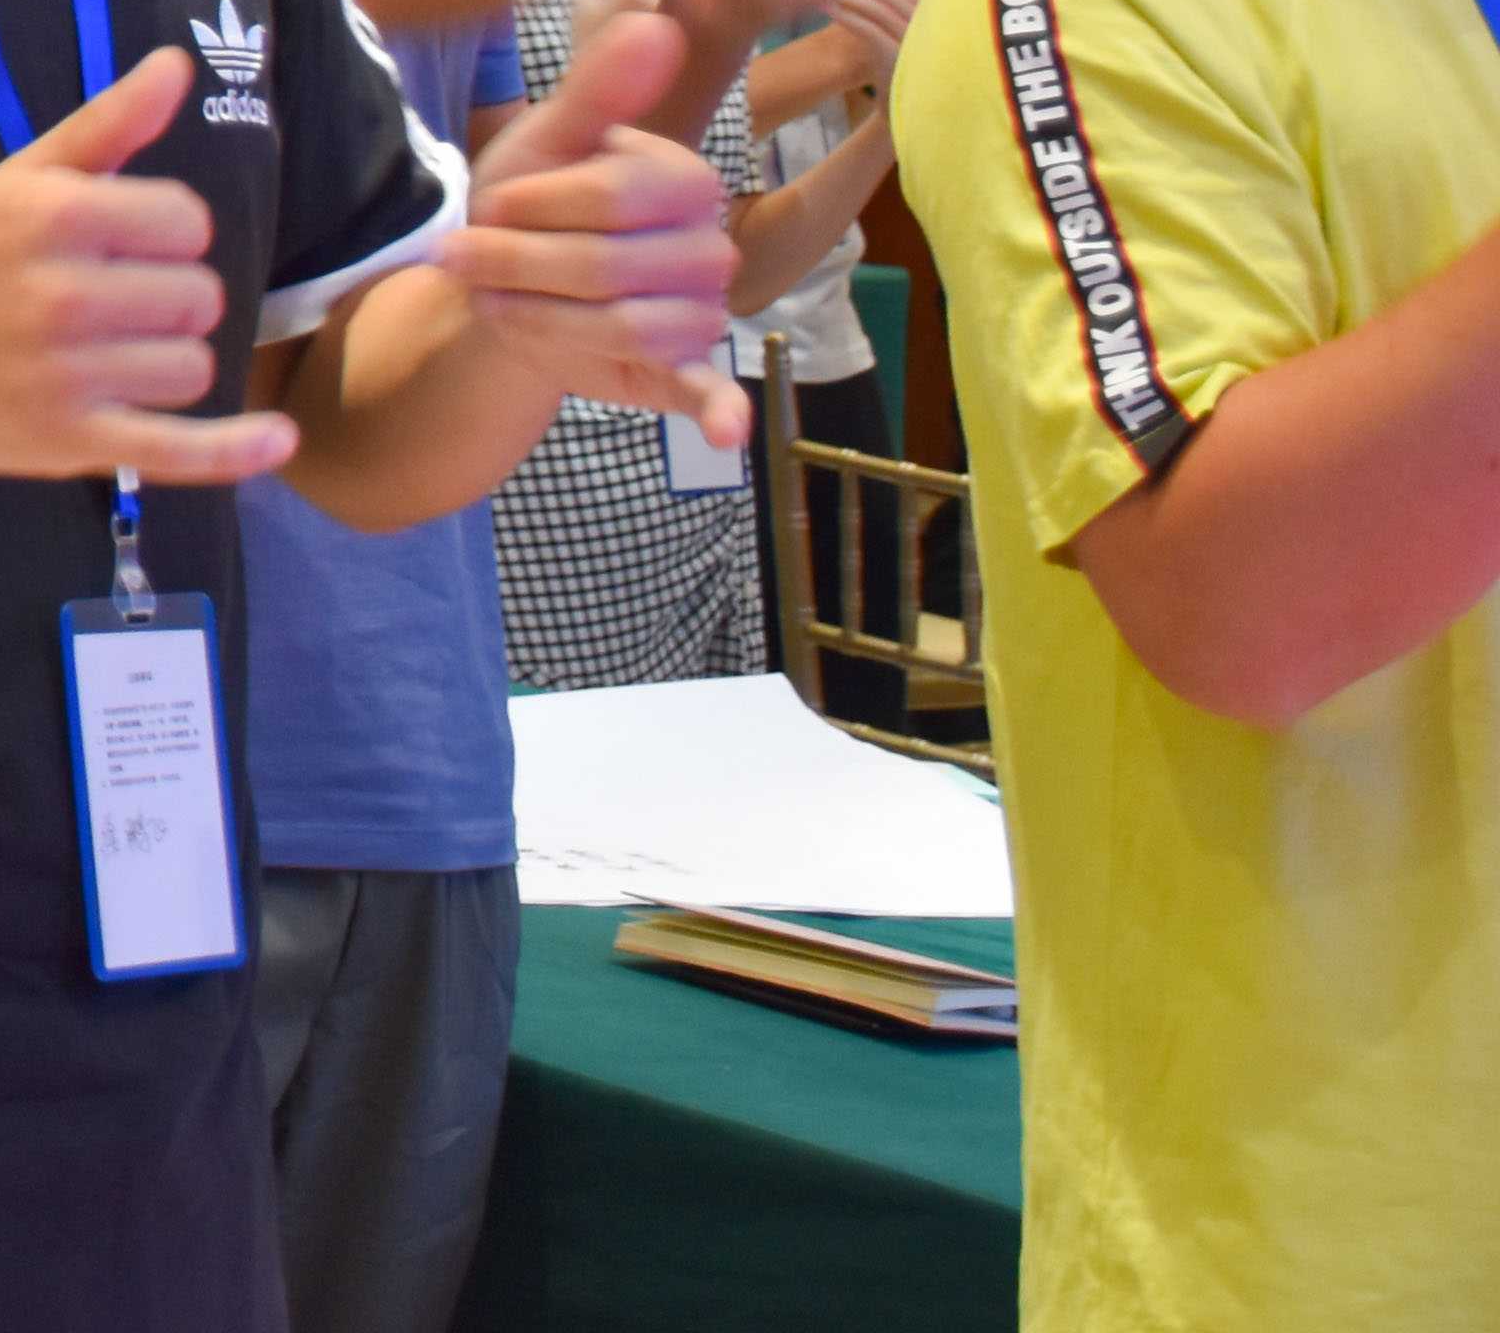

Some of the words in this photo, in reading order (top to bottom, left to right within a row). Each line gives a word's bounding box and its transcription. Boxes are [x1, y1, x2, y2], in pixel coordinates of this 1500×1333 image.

[203, 88, 269, 126] adidas
[1006, 39, 1070, 132] THE
[1031, 135, 1135, 318] OUTSIDE
[1090, 318, 1166, 432] THNK
